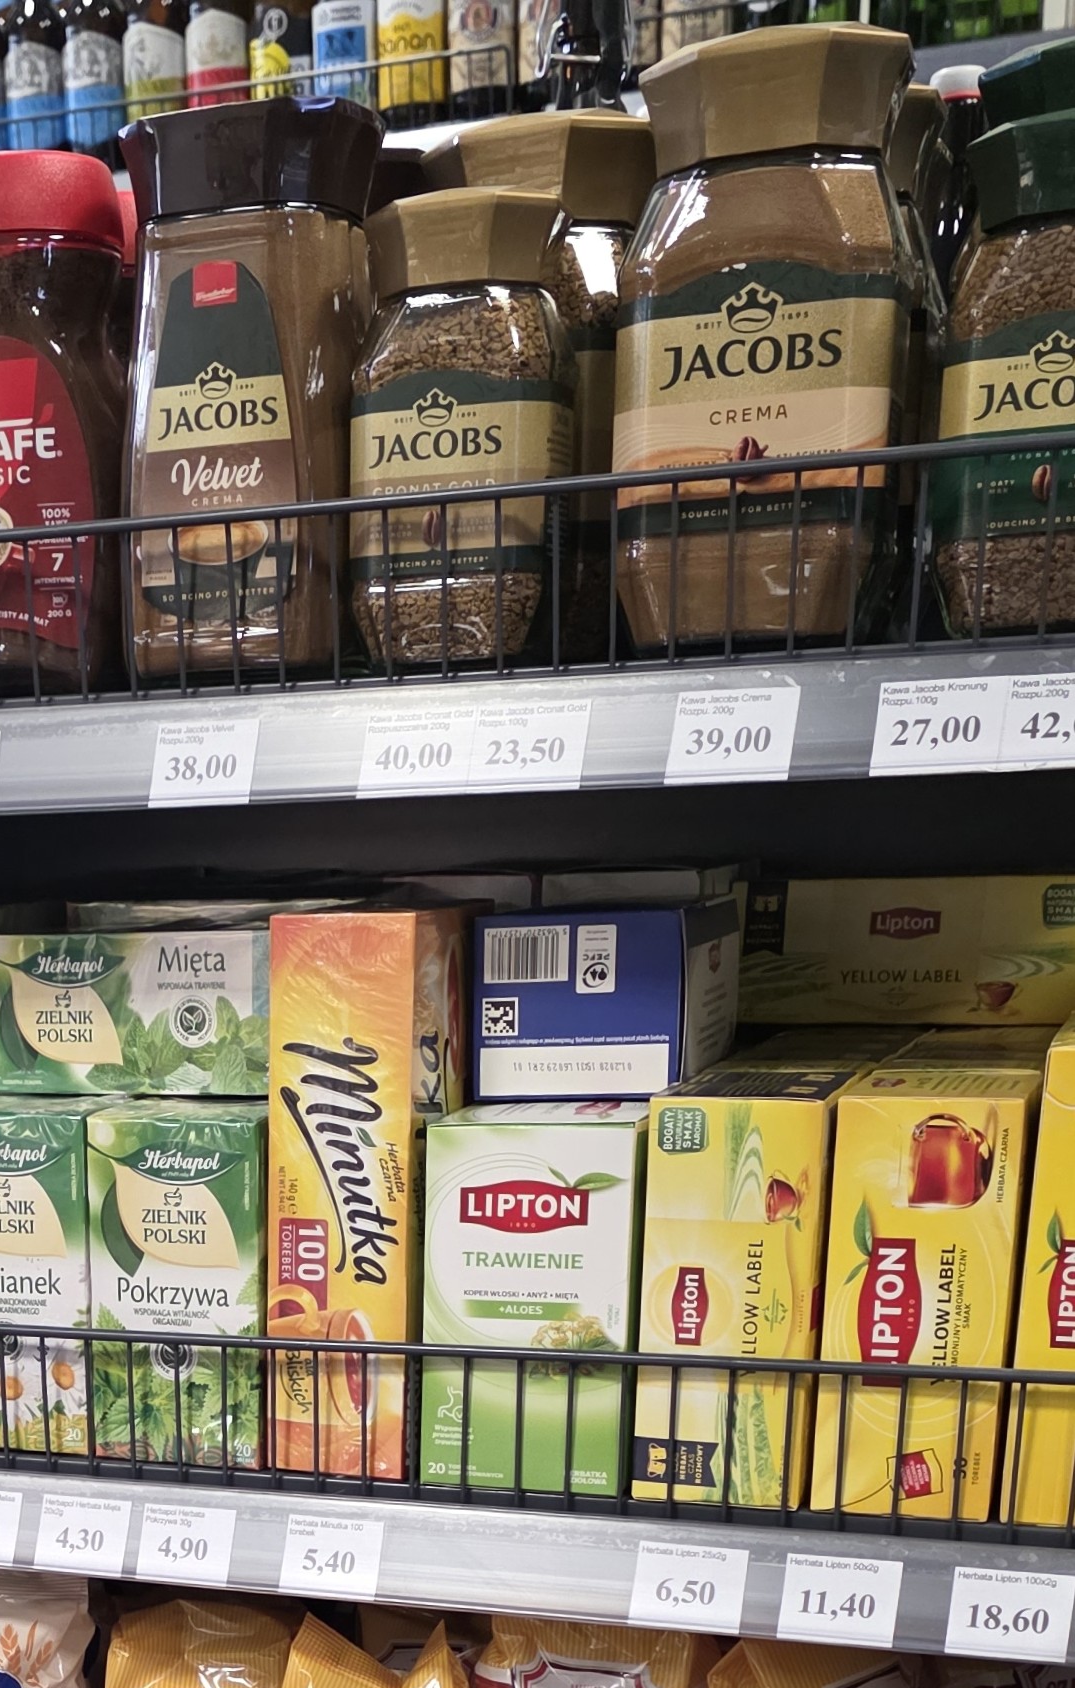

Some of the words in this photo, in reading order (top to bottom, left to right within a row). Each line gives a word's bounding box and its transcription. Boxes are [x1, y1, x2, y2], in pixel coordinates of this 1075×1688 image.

[695, 321, 722, 330] SEIT
[781, 311, 809, 320] 1895
[659, 329, 843, 391] JACOBS
[974, 375, 1075, 421] JACO
[158, 396, 278, 440] JACOBS
[709, 404, 788, 425] CREMA
[369, 425, 502, 469] JACOBS
[170, 456, 263, 496] Velvet
[41, 507, 71, 520] 100%
[191, 493, 244, 507] CREMA
[883, 686, 909, 695] Kawa
[912, 683, 944, 694] Jacobs
[948, 681, 989, 693] Kronung
[684, 725, 772, 760] 39,00
[890, 715, 981, 750] 27,00
[375, 742, 452, 774] 40,00
[484, 737, 565, 769] 23,50
[165, 753, 237, 785] 38,00
[876, 914, 935, 935] Lipton
[35, 952, 105, 975] Herbapol
[157, 945, 226, 976] Mięta
[840, 969, 908, 985] YELLOW
[913, 969, 962, 983] LABEL
[35, 1010, 94, 1026] ZIELNIK
[36, 1028, 94, 1044] POLSKI
[683, 1112, 693, 1148] SMAK
[280, 1037, 399, 1286] Minutka
[467, 1192, 581, 1219] LIPTON
[282, 1224, 292, 1280] TOREBEK
[297, 1224, 325, 1281] 100
[462, 1251, 584, 1270] TRAWIENIE
[746, 1239, 764, 1295] LABEL
[938, 1244, 956, 1302] LABEL
[116, 1277, 230, 1309] Pokrzywa
[463, 1289, 489, 1298] KOPER
[490, 1289, 520, 1298] WŁOSKI
[527, 1290, 548, 1299] ANYŻ
[554, 1291, 579, 1301] MIĘTA
[679, 1274, 700, 1339] Lipton
[428, 1462, 446, 1475] 20
[55, 1526, 105, 1555] 4,30
[157, 1535, 208, 1565] 4,90
[302, 1548, 356, 1576] 5,40
[655, 1577, 716, 1608] 6,50
[958, 1571, 992, 1583] Herbata
[995, 1574, 1022, 1585] Lipton
[799, 1588, 876, 1620] 11,40
[966, 1602, 1050, 1637] 18,60
